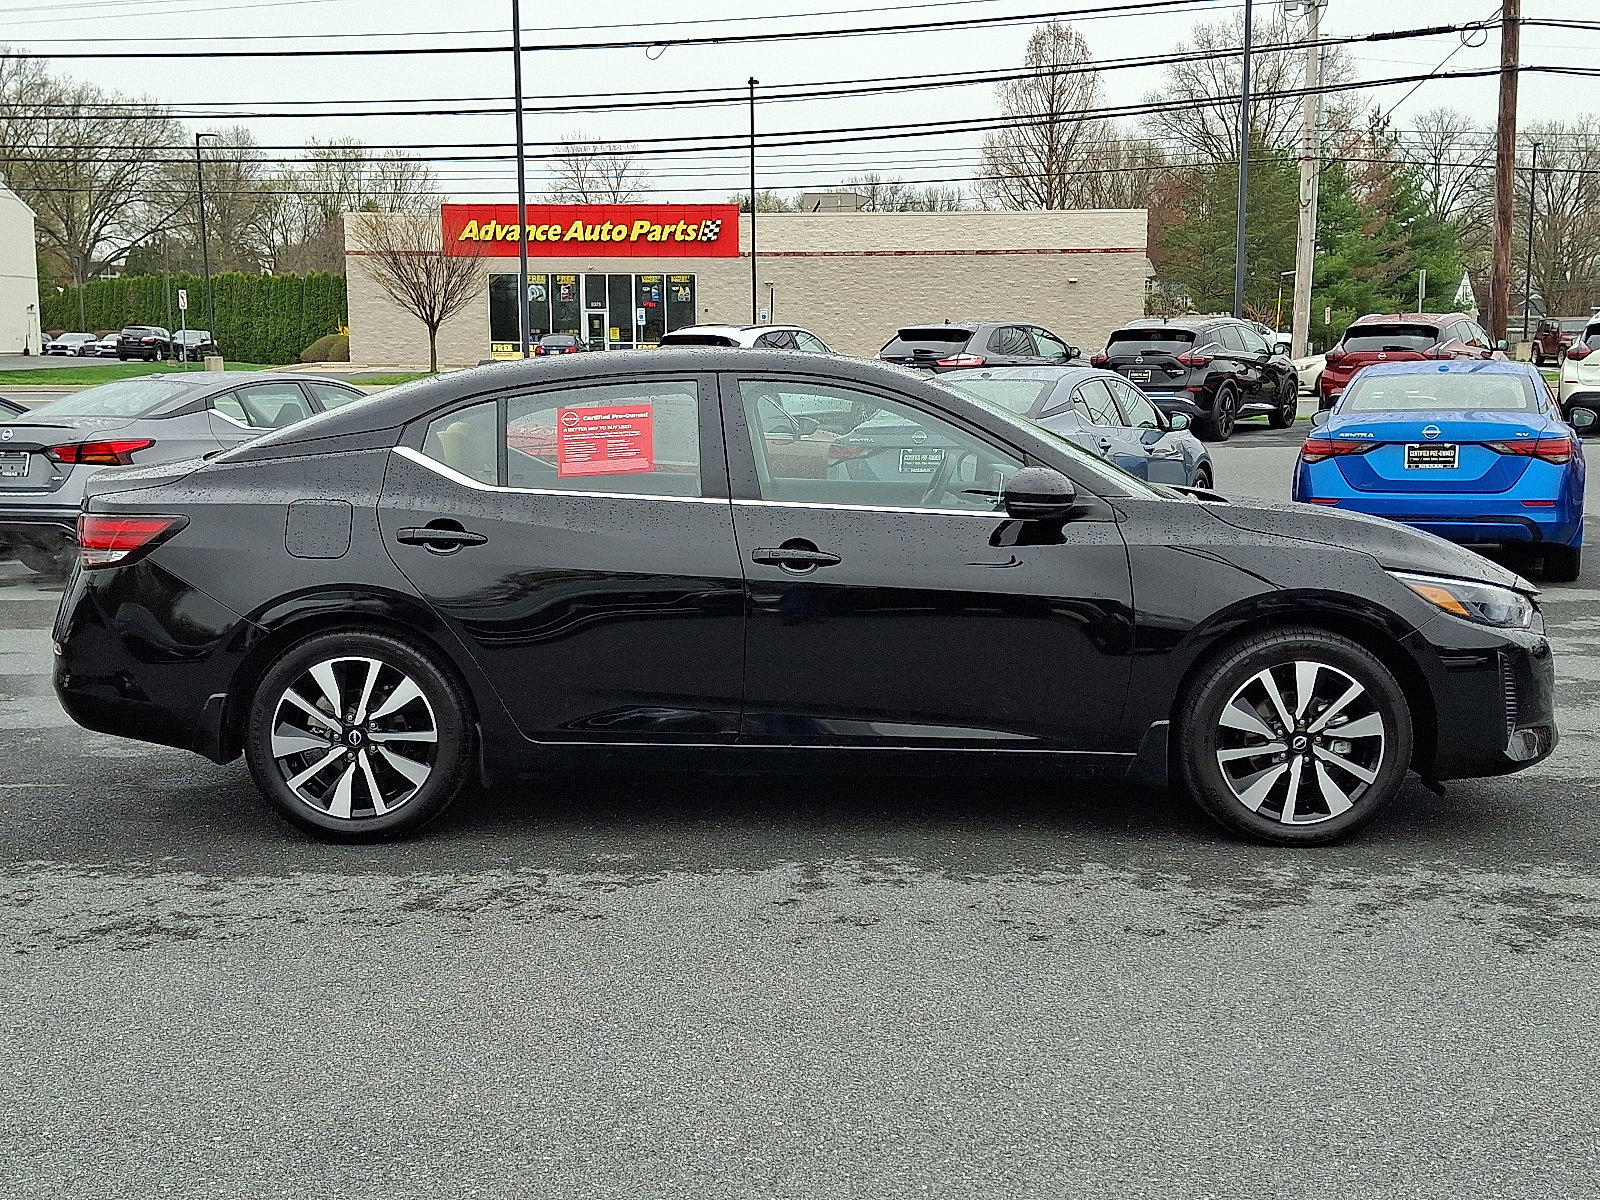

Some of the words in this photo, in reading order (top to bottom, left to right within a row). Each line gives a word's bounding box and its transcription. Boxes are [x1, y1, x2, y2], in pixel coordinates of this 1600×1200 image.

[458, 220, 561, 241] Advance
[563, 220, 628, 241] Auto
[630, 220, 698, 241] Parts
[492, 344, 513, 352] FREE
[612, 412, 648, 420] Pre-Owned
